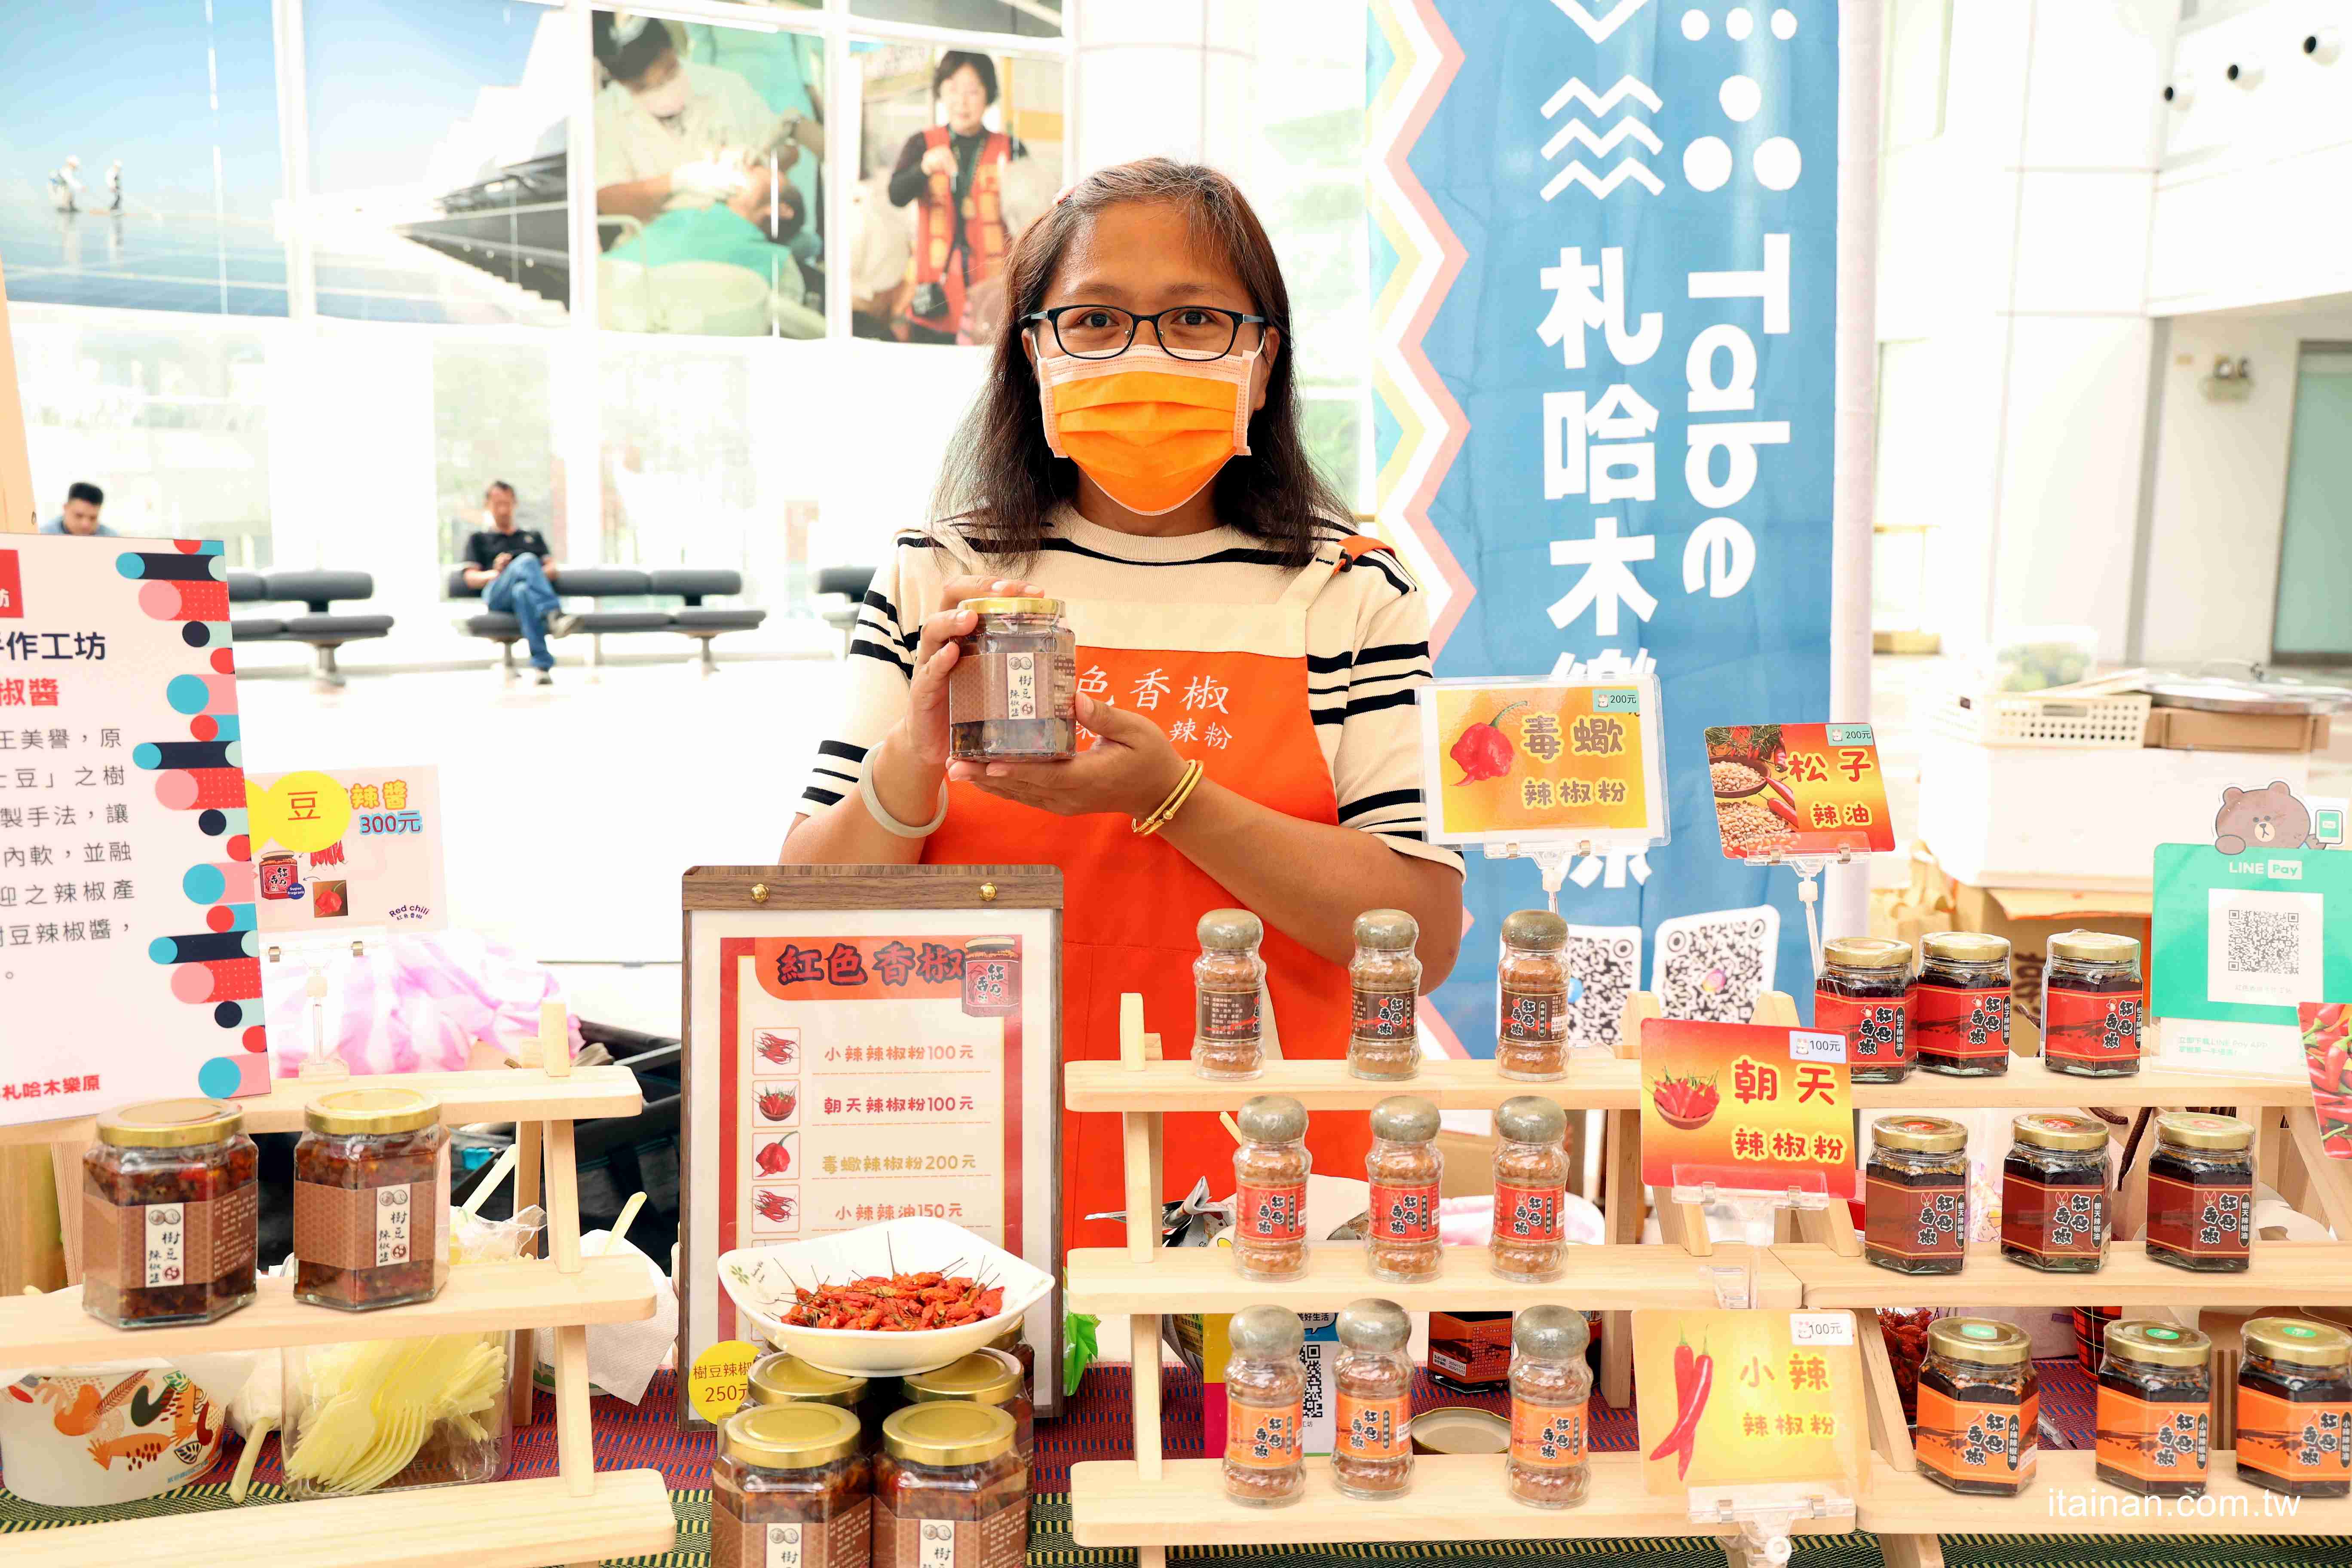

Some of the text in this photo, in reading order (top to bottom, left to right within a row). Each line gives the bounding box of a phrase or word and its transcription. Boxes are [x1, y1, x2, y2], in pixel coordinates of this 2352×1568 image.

[1682, 233, 1790, 598] Tabe
[0, 678, 59, 706] 椒醬
[1076, 665, 1229, 714] 色香椒
[1610, 694, 1637, 704] 200元
[1169, 718, 1233, 750] 辣粉
[1523, 714, 1624, 760] 毒蠍
[1846, 731, 1871, 740] 200元
[1787, 750, 1871, 783] 松子
[288, 791, 321, 821] 豆
[350, 780, 407, 810] 辣醬
[1524, 780, 1626, 806] 辣椒粉
[361, 811, 422, 834] 300元
[1813, 804, 1870, 826] 辣油
[2229, 861, 2298, 876] LINE Pay
[389, 904, 430, 917] Red chili
[0, 919, 131, 946] 豆辣椒醬，
[776, 940, 966, 987] 紅色香椒
[1875, 1006, 1893, 1043] 紅色
[1984, 995, 2001, 1032] 紅色
[2117, 999, 2134, 1036] 紅色
[1809, 1040, 1841, 1053] 100元
[1896, 1014, 1904, 1051] 松子辣椒油
[824, 1045, 974, 1062] 小辣辣椒粉100元
[2, 1075, 100, 1101] 札哈木樂原
[1733, 1059, 1835, 1106] 朝天
[824, 1096, 974, 1115] 朝天辣椒粉100元
[1734, 1127, 1844, 1161] 辣椒粉
[822, 1155, 977, 1174] 毒蠍辣椒粉200元
[835, 1203, 963, 1220] 小辣辣油150元
[1935, 1194, 1955, 1233] 紅色
[2070, 1194, 2091, 1233] 紅色
[2093, 1202, 2101, 1240] 朝天辣椒油
[2218, 1193, 2239, 1231] 紅色
[1808, 1322, 1843, 1335] 100元
[693, 1361, 752, 1380] 樹豆辣椒
[1739, 1353, 1829, 1391] 小辣
[705, 1383, 747, 1403] 250元
[1743, 1412, 1834, 1436] 辣椒粉
[1983, 1412, 2007, 1454] 紅色
[2174, 1412, 2195, 1454] 紅色
[2318, 1411, 2339, 1452] 紅色
